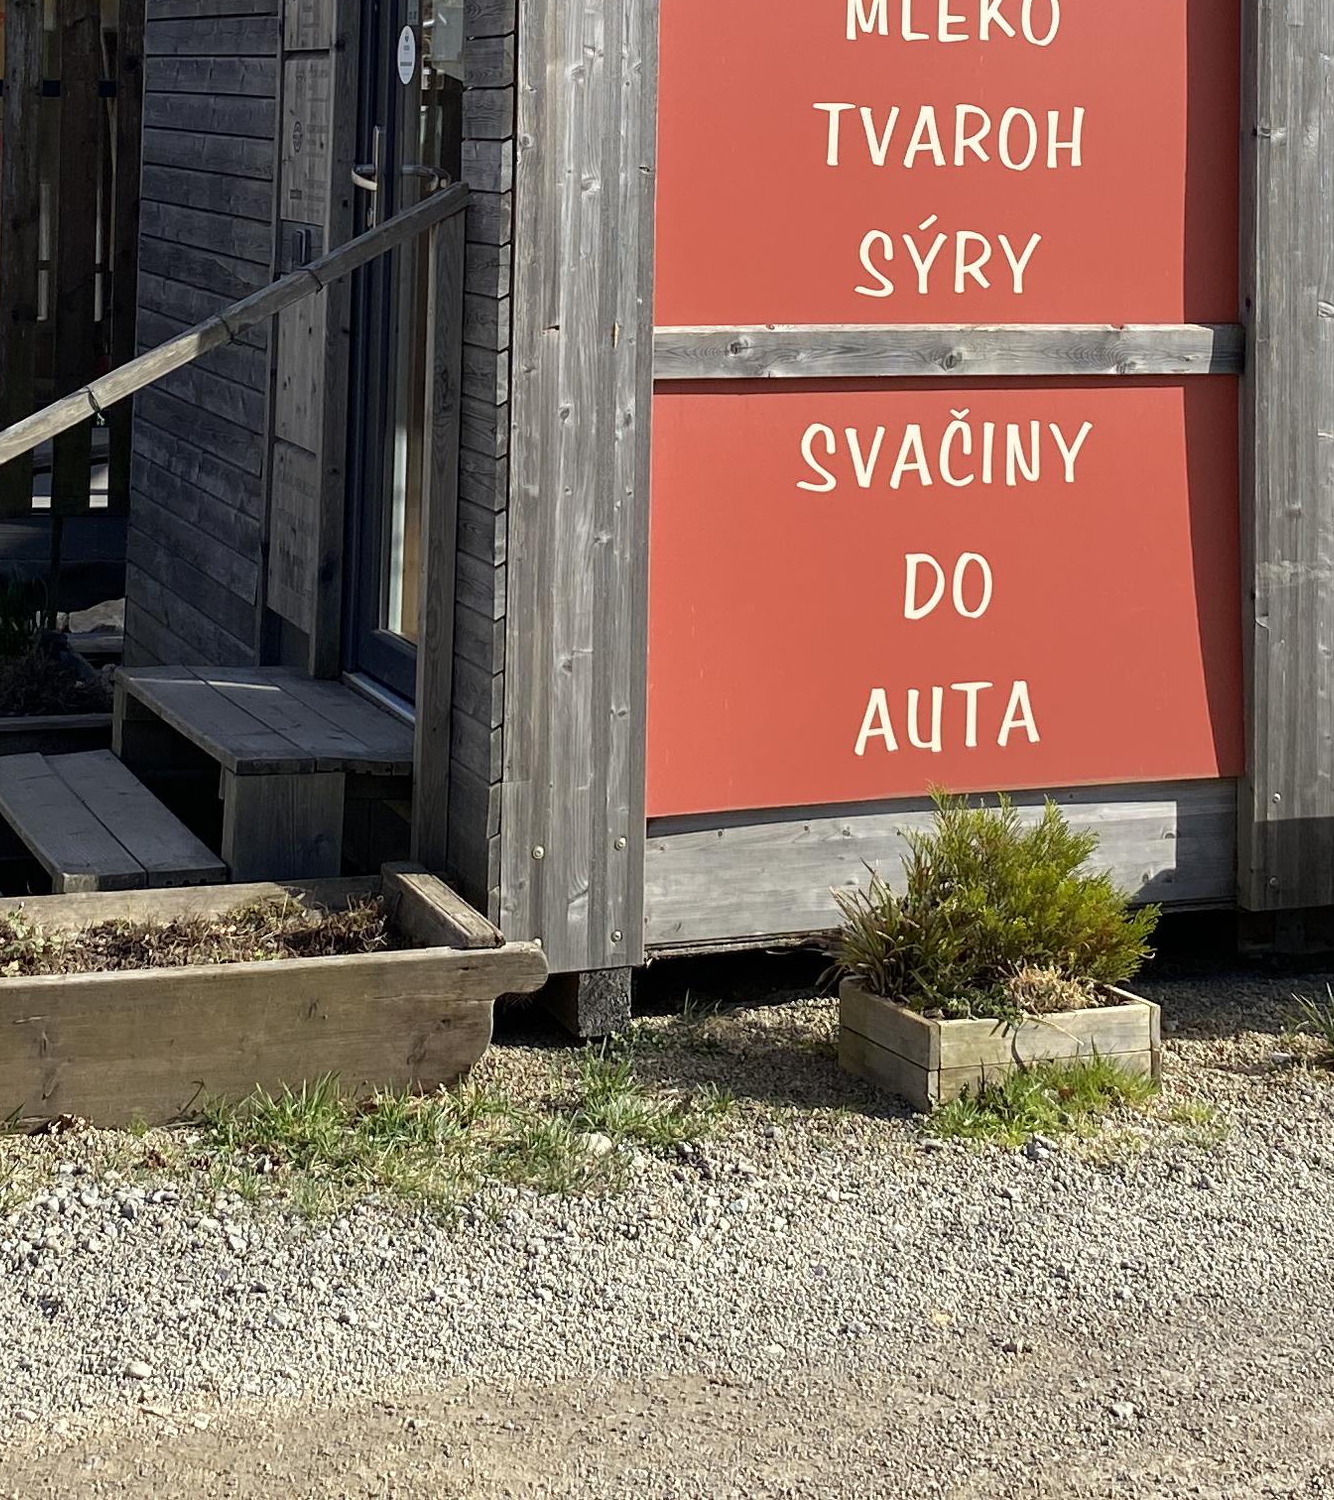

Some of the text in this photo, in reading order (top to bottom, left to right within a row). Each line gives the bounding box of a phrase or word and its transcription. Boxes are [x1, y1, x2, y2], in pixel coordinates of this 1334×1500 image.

[812, 102, 1086, 171] TVAROH
[854, 214, 1043, 298] SÝRY
[795, 407, 1094, 493] SVAČINY
[903, 551, 994, 620] DO
[853, 680, 1041, 757] AUTA
